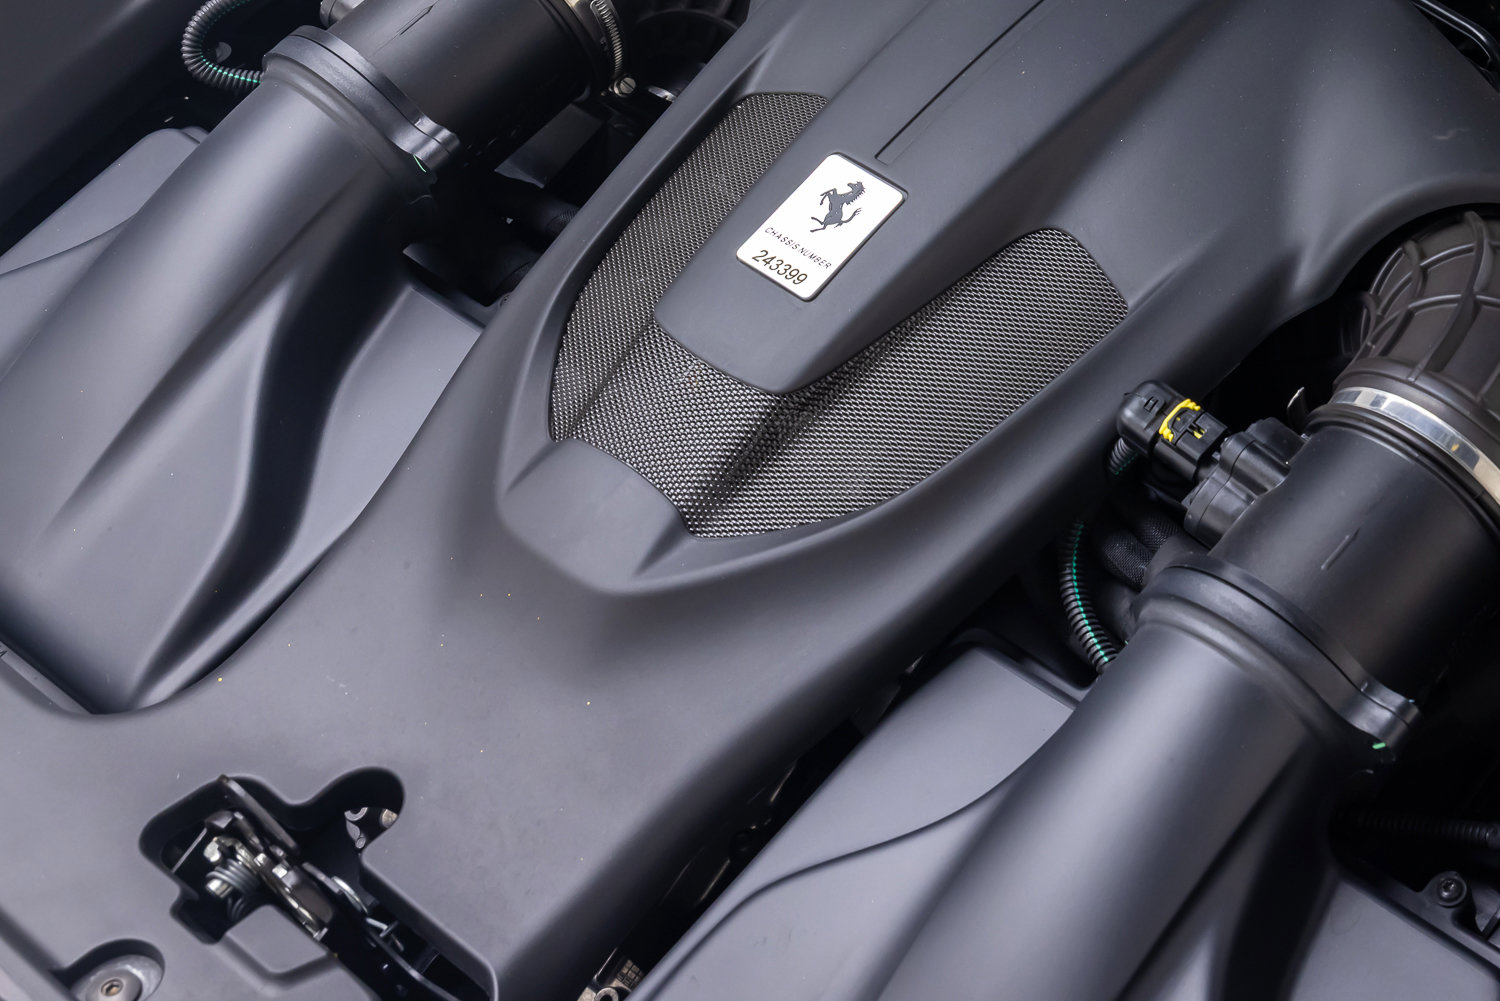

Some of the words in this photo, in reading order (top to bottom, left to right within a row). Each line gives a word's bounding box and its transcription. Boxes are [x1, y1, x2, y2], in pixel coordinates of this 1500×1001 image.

[752, 249, 807, 285] 243399
[764, 226, 801, 250] CHASSIS
[798, 247, 832, 270] NUMBER
